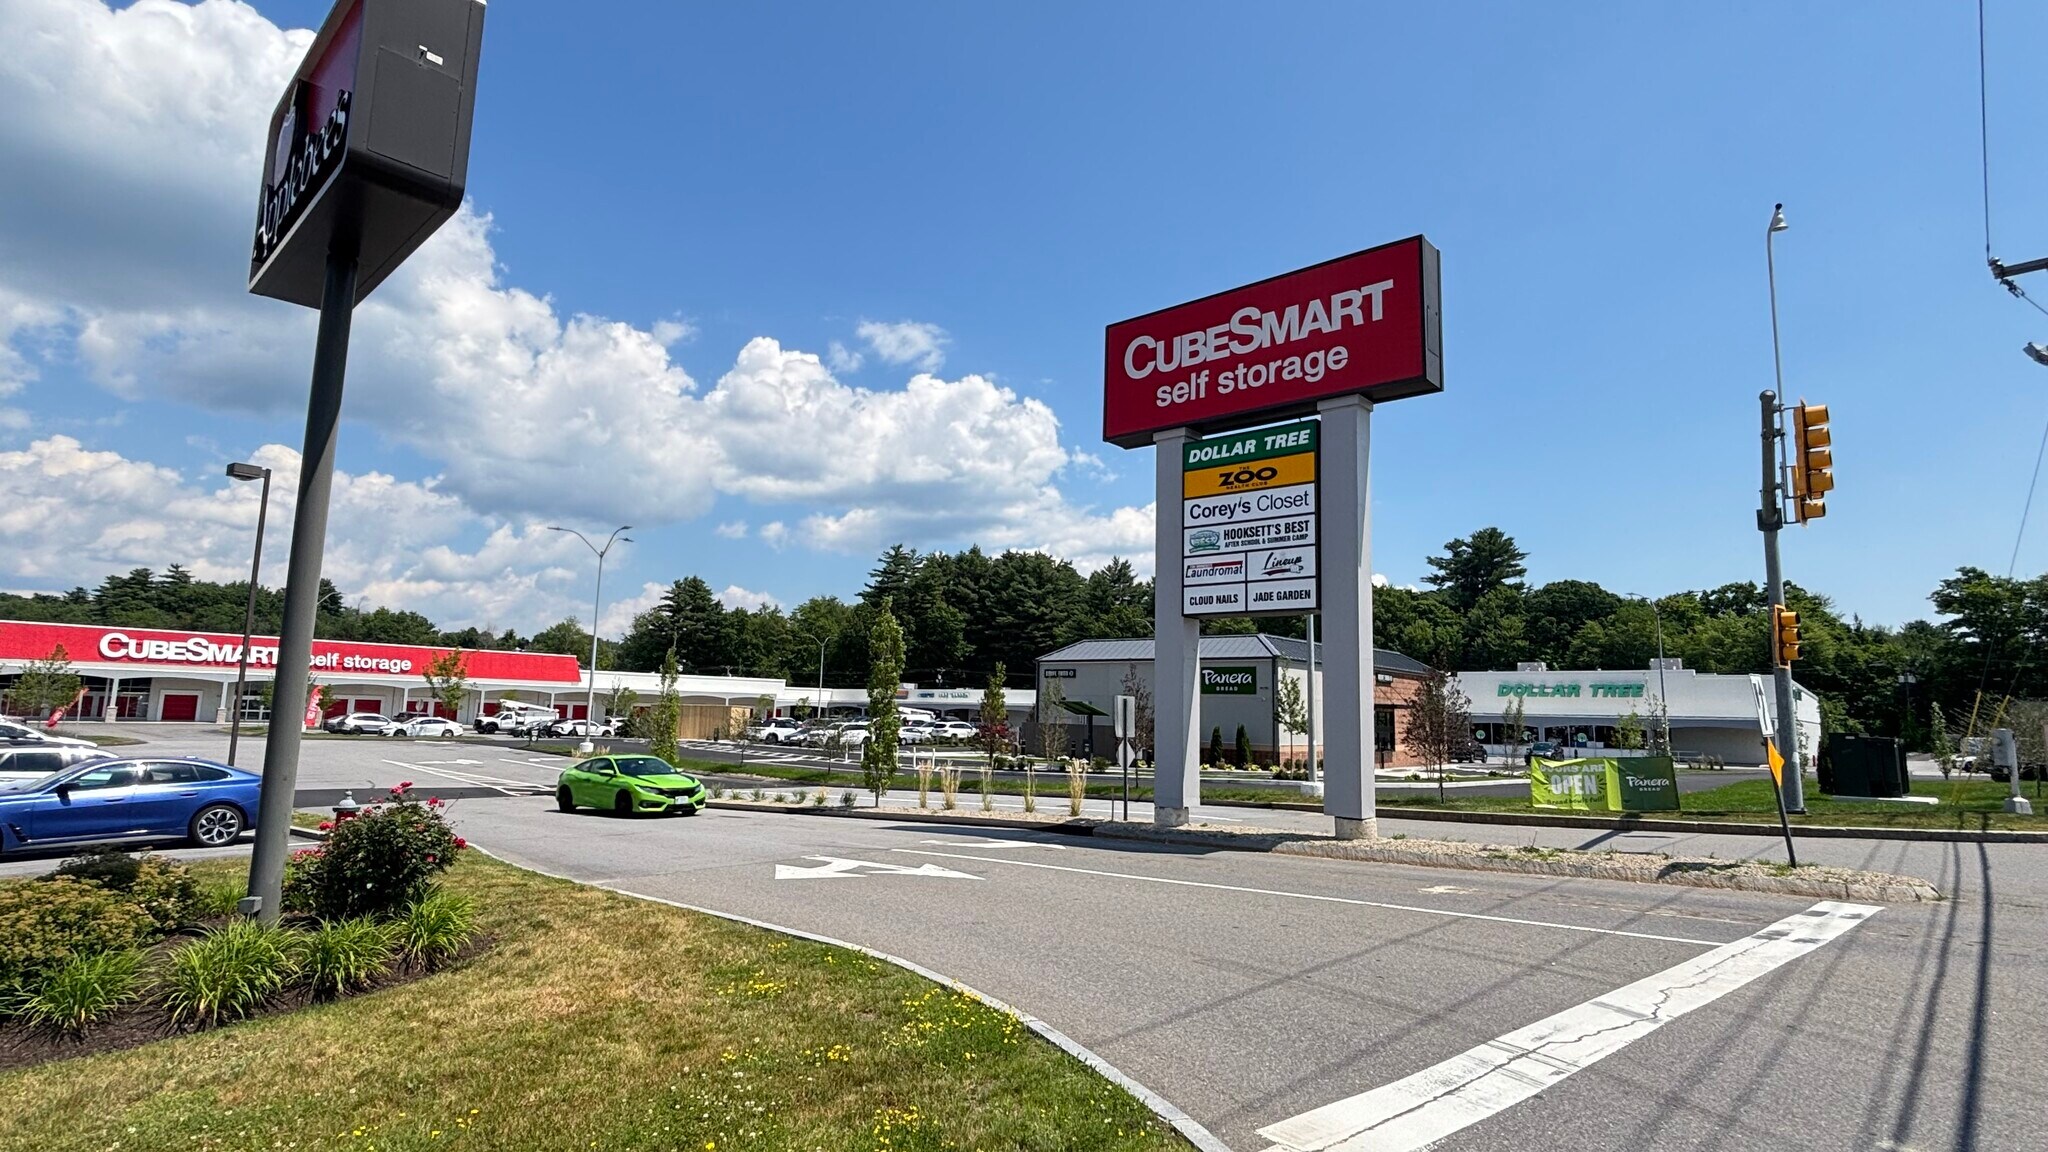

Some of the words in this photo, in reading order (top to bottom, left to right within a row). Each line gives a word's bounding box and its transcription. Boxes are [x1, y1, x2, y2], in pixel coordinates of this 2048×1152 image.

[1156, 369, 1210, 407] self
[1217, 345, 1349, 395] storage
[1188, 439, 1257, 464] DOLLAR
[1264, 429, 1311, 451] TREE
[1218, 466, 1278, 487] ZOO
[1189, 497, 1251, 520] Corey's
[1256, 490, 1310, 512] Closet
[1223, 523, 1281, 541] HOOKSETT'S
[1284, 520, 1310, 534] BEST
[1292, 533, 1309, 541] CAMP
[1185, 563, 1243, 578] Laundromat
[1189, 595, 1214, 606] CLOUD
[1215, 593, 1239, 605] NAILS
[1253, 591, 1274, 603] JADE
[1276, 589, 1311, 601] GARDEN
[342, 655, 412, 674] storage
[1201, 669, 1253, 685] Panera
[1497, 683, 1581, 698] DOLLAR
[1589, 683, 1645, 698] TREE
[1551, 774, 1598, 795] OPEN
[1625, 775, 1670, 787] Panera
